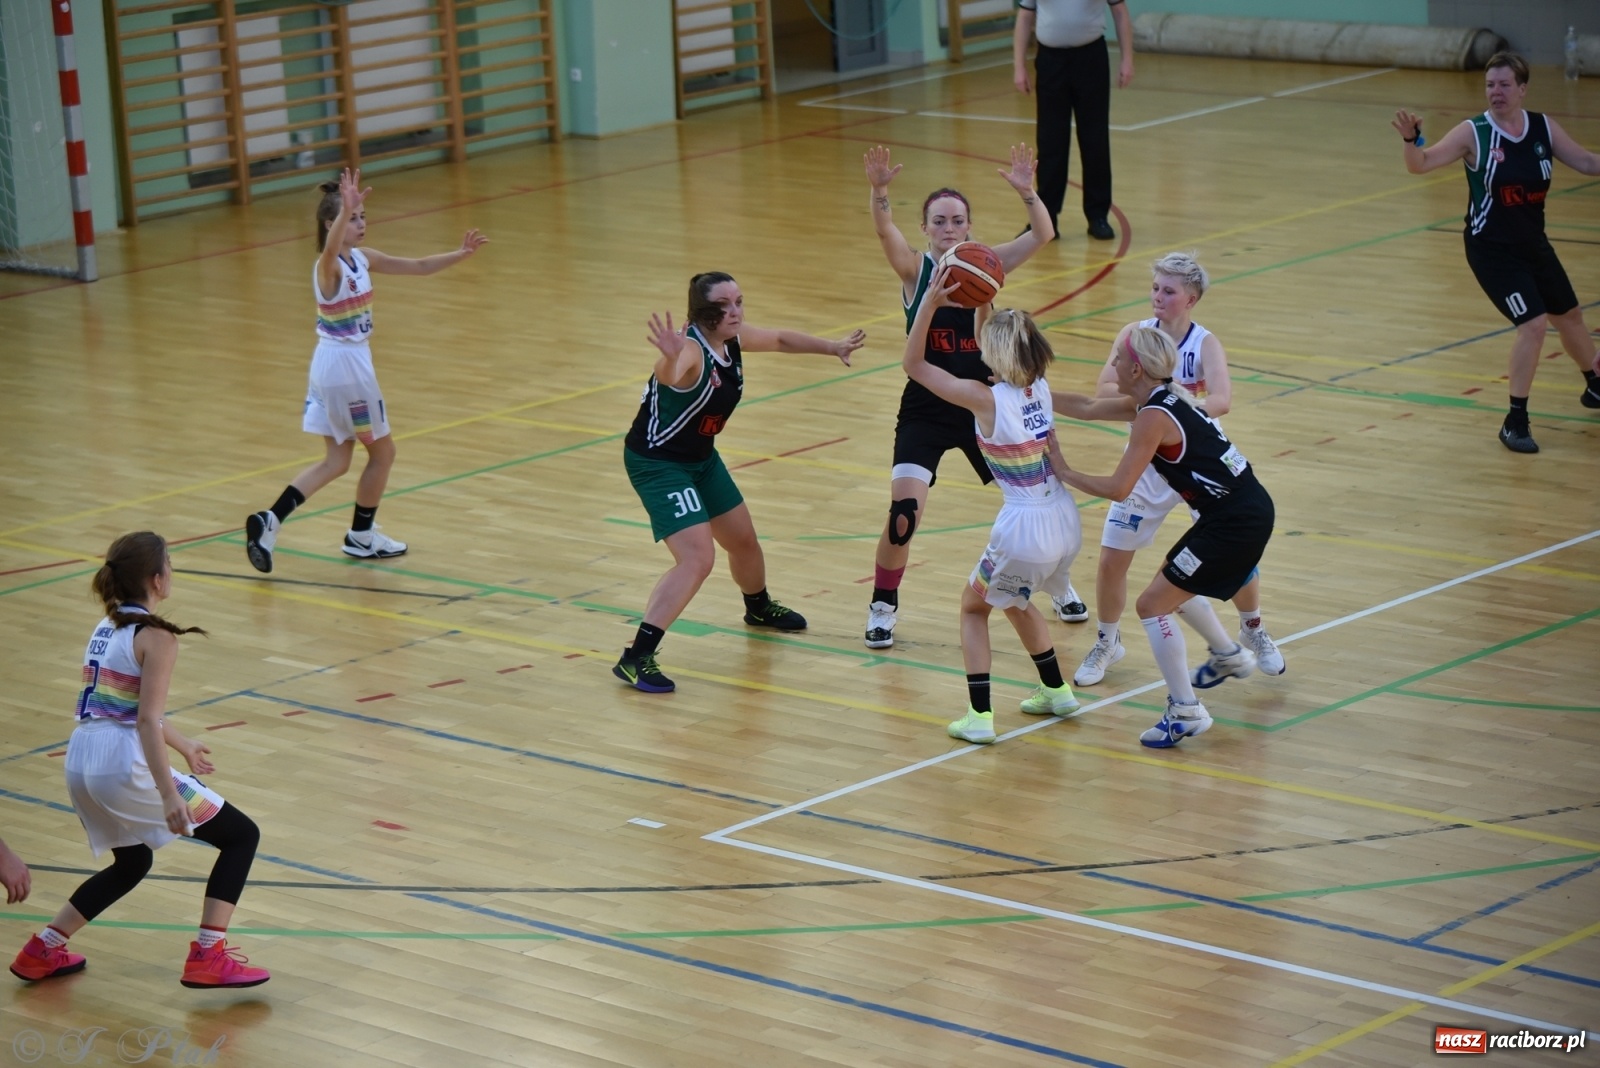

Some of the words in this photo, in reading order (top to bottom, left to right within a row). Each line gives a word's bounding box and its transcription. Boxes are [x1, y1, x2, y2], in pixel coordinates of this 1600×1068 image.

[1505, 292, 1528, 318] 10
[1182, 351, 1195, 378] 10
[667, 487, 702, 518] 30
